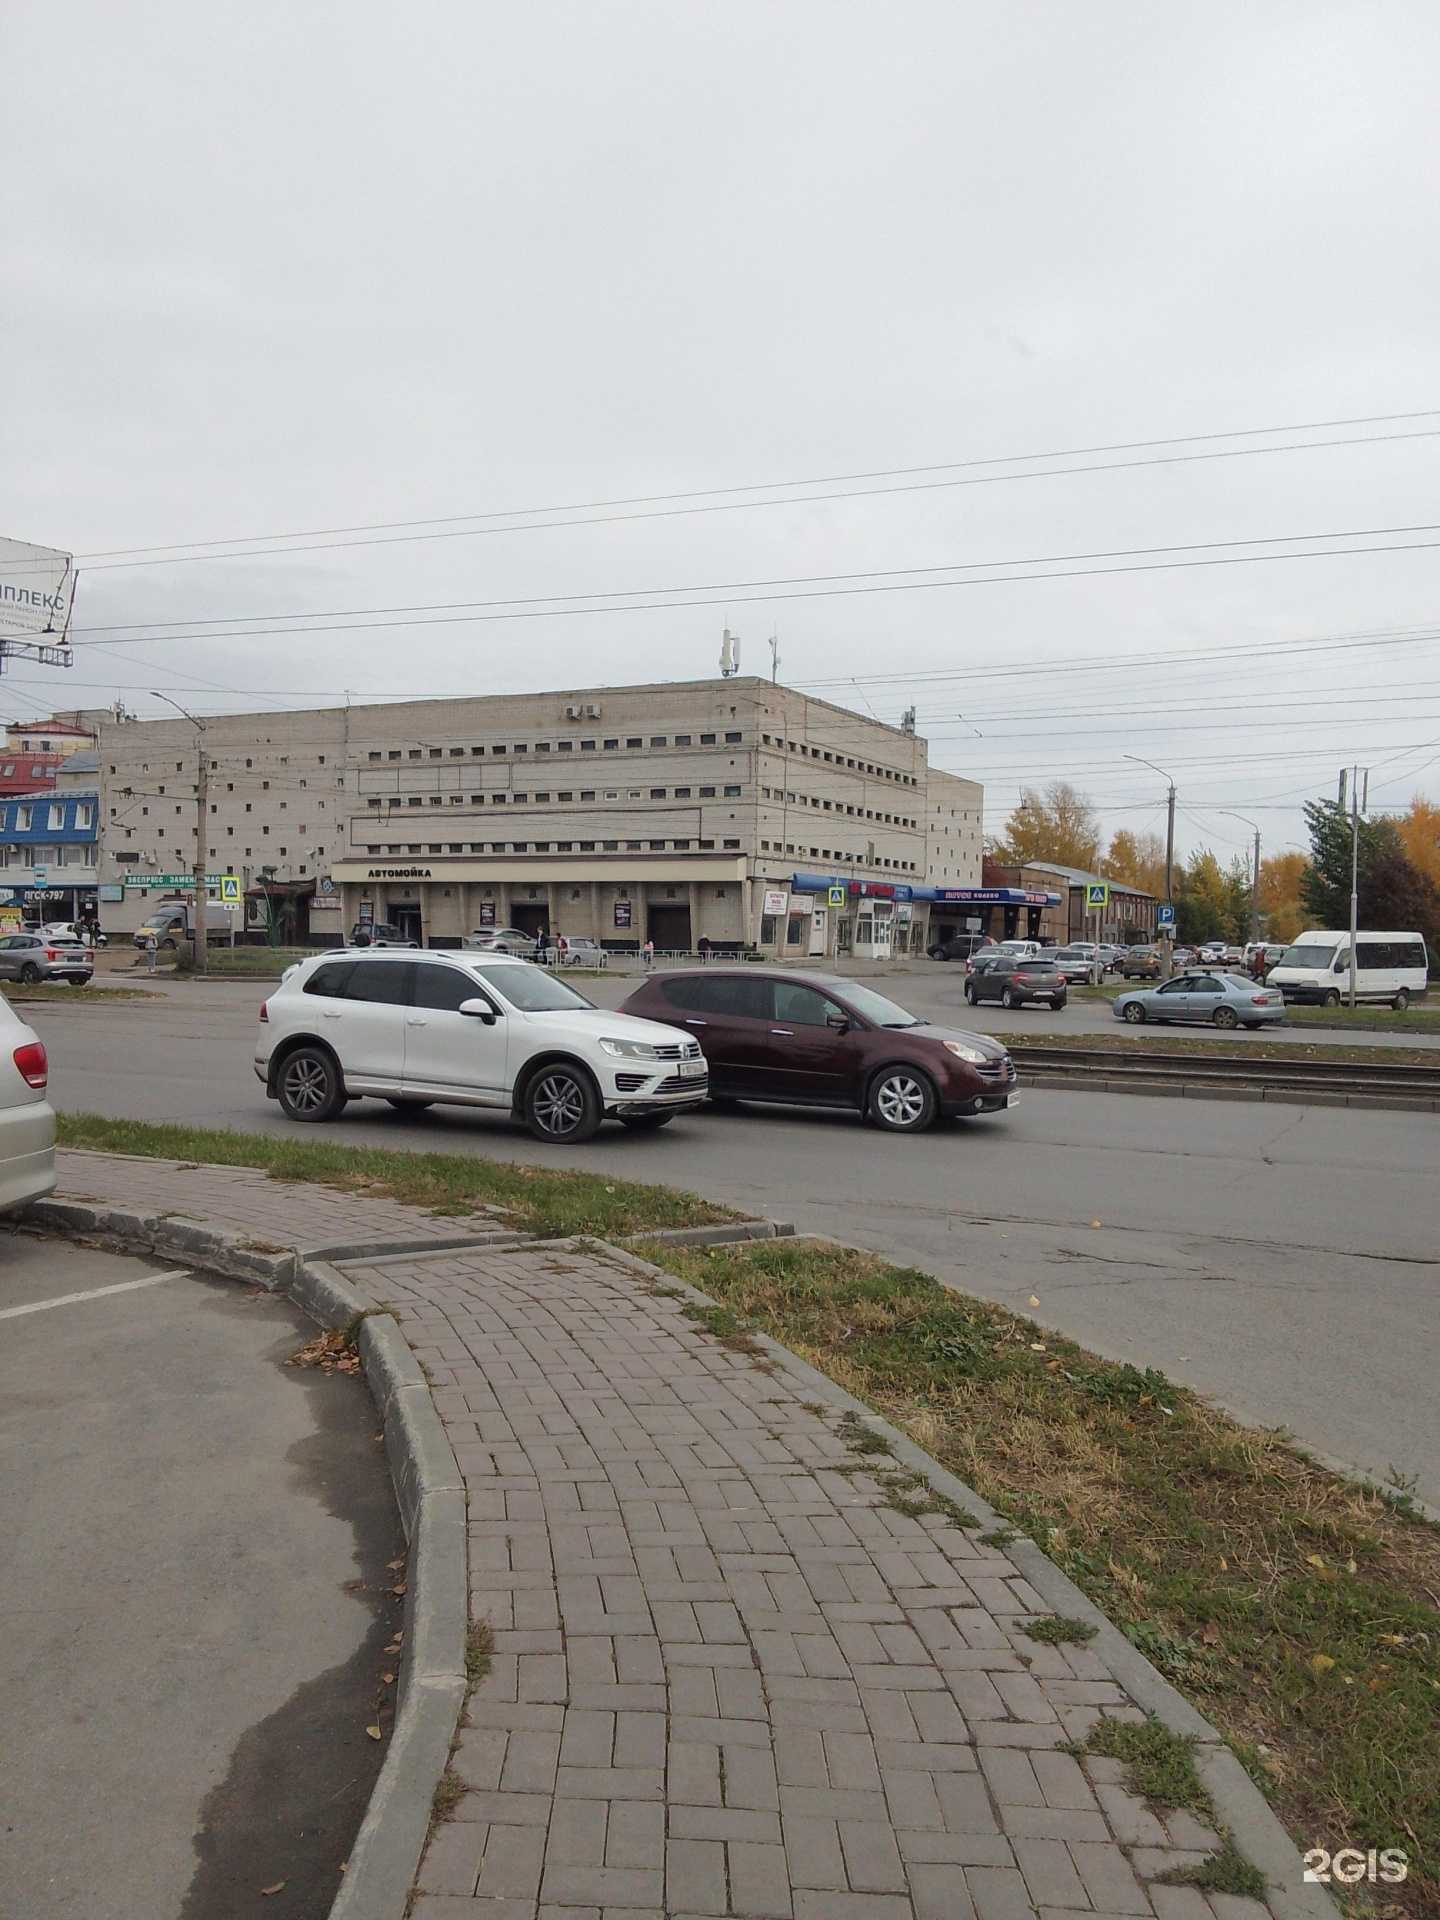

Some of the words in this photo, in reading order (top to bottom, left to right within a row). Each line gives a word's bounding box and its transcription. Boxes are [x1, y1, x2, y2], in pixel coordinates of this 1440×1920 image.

[0, 585, 65, 610] ПЛЕКС
[368, 866, 432, 878] АВТОМОЙКА
[1162, 908, 1172, 921] P
